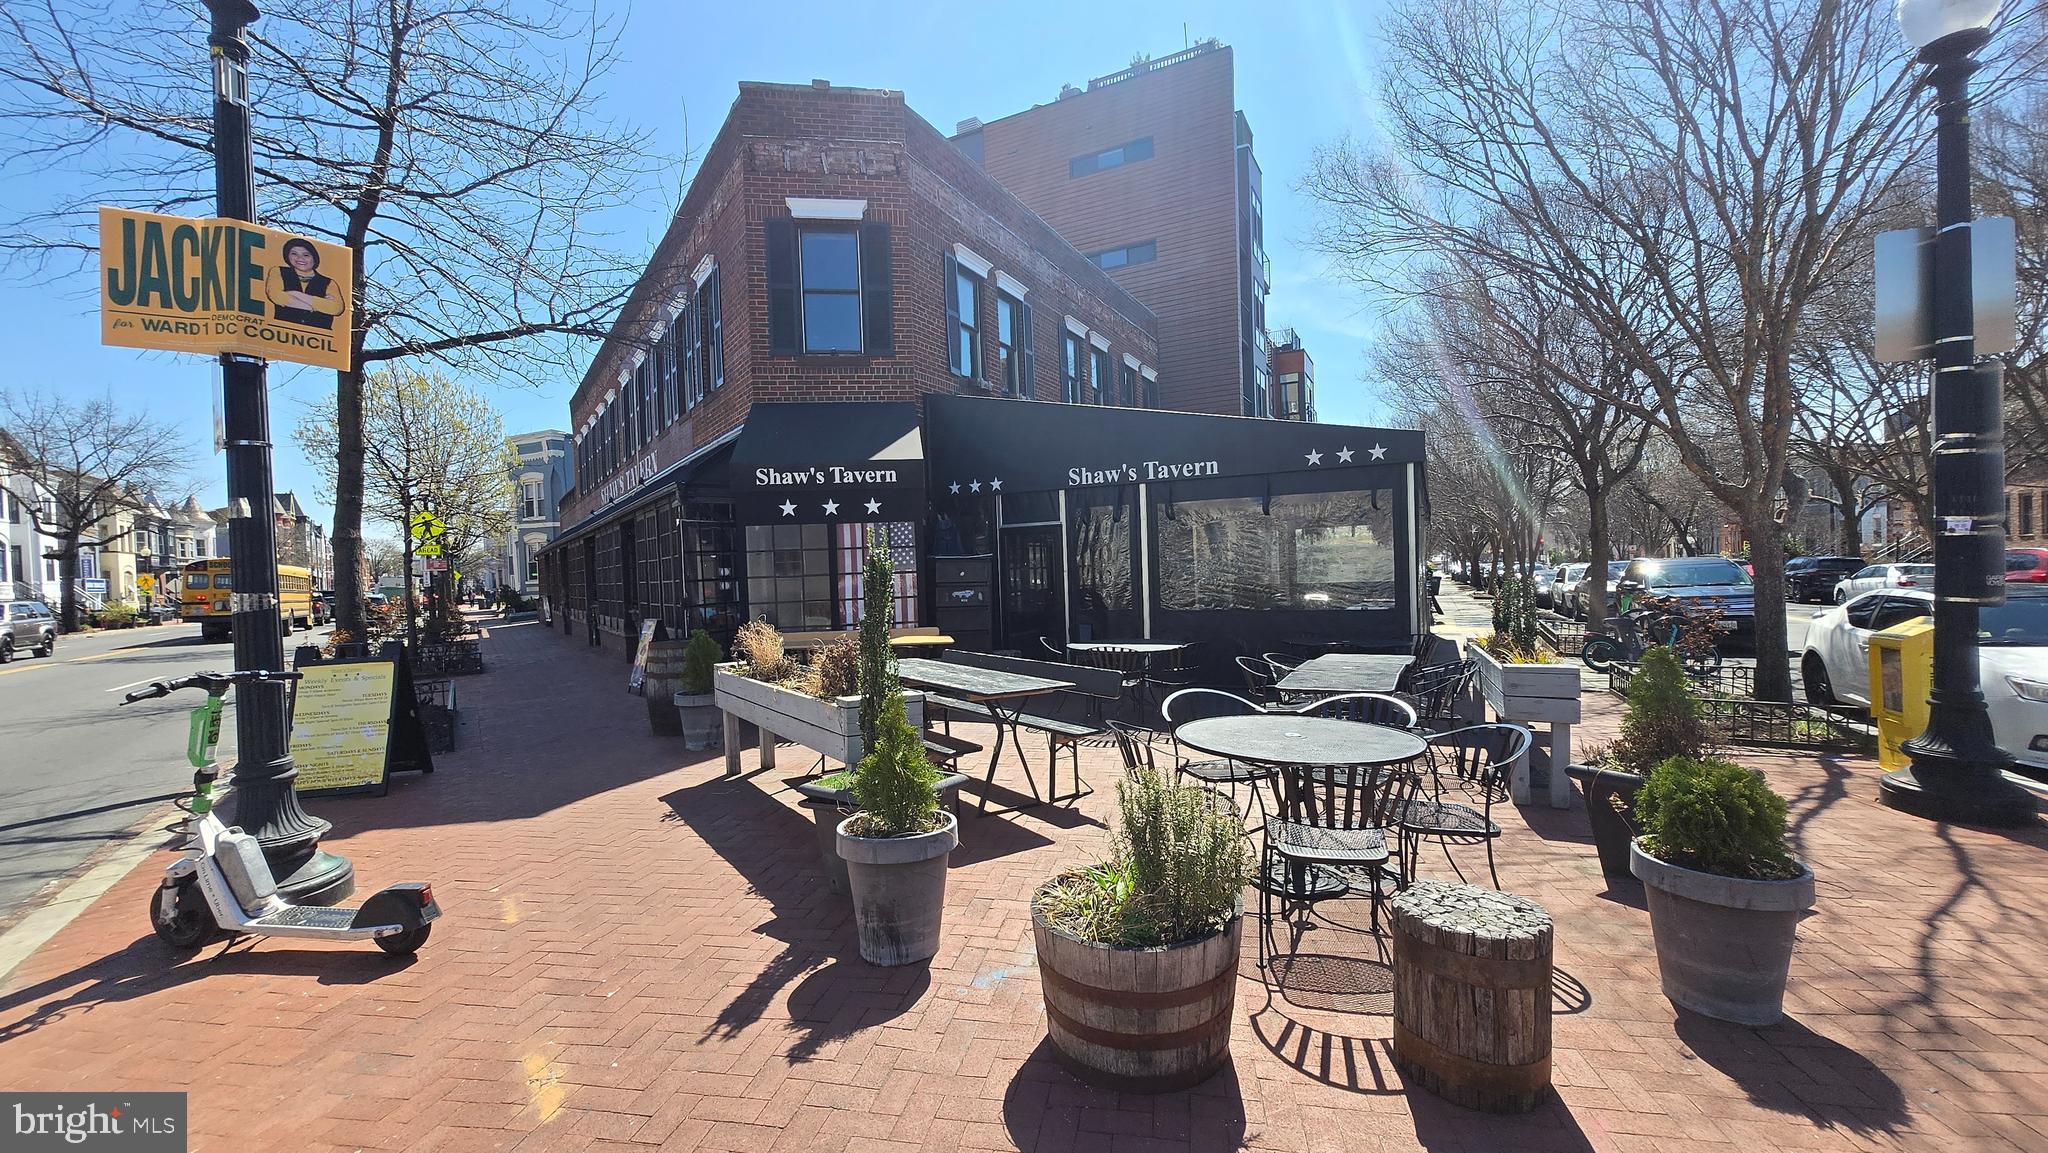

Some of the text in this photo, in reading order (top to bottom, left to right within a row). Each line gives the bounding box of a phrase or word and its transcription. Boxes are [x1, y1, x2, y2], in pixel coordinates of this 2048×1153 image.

[107, 217, 266, 316] JACKIE
[211, 314, 265, 326] DEMOCRAT
[112, 318, 134, 330] for
[141, 318, 200, 336] WARD
[202, 322, 209, 335] 1
[215, 322, 238, 335] DC
[243, 325, 338, 353] COUNCIL
[755, 466, 897, 486] Shaw's Tavern
[1068, 460, 1220, 486] Shaw's Tavern
[209, 561, 232, 569] SCHOO
